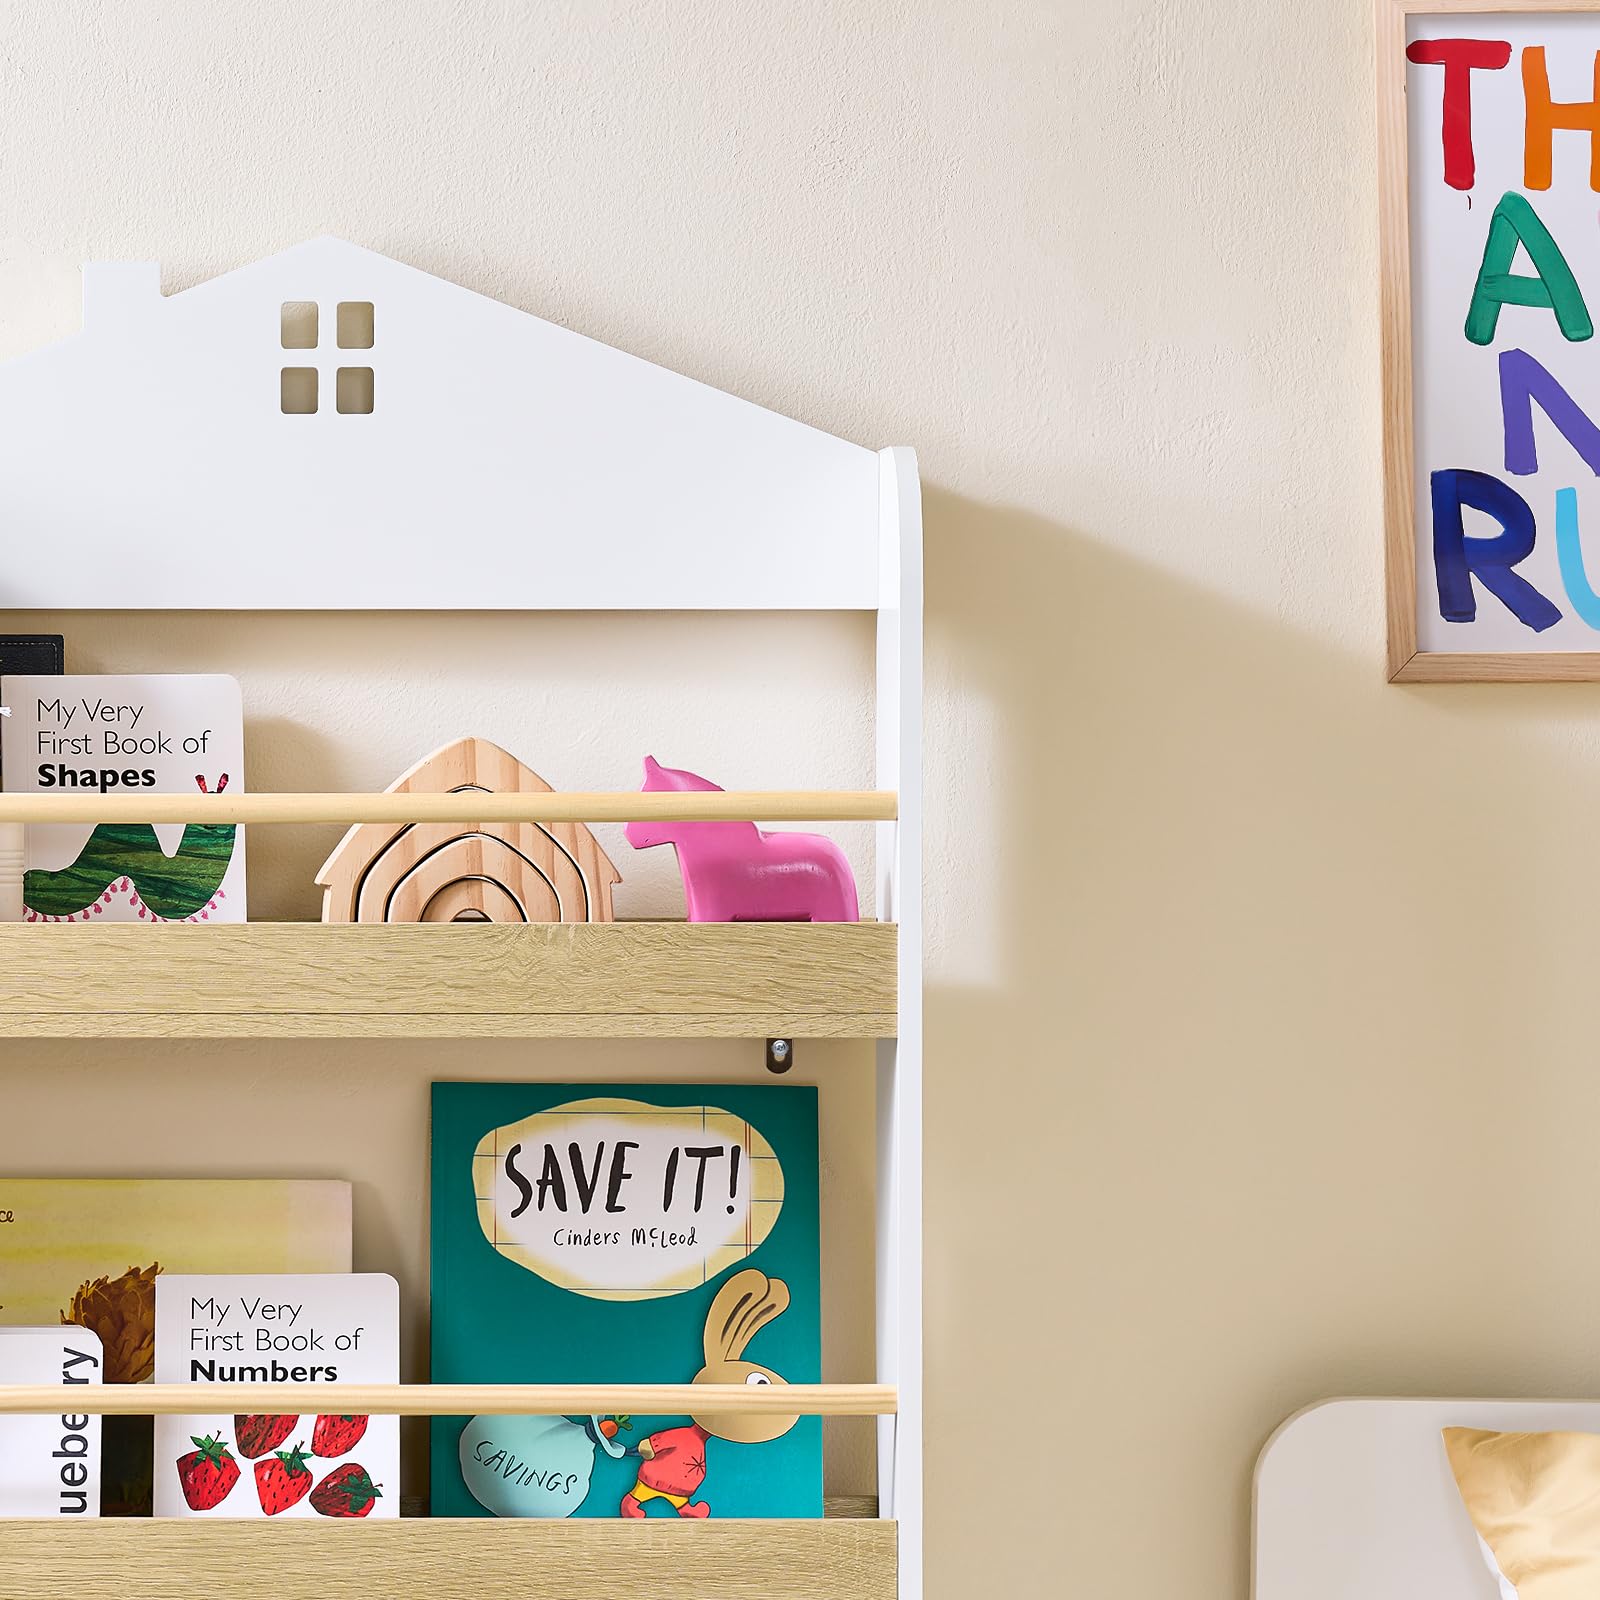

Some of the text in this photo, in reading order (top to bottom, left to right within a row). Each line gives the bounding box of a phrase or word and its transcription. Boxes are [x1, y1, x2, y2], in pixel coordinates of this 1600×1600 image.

[37, 698, 144, 730] My Very
[37, 729, 212, 755] First Book of
[37, 763, 156, 793] Shapes
[504, 1140, 742, 1219] SAVE IT!
[553, 1226, 698, 1249] Cinders McLeod
[190, 1297, 303, 1327] My Very
[190, 1327, 364, 1352] First Book of
[190, 1358, 338, 1383] Numbers
[473, 1440, 578, 1495] SAVINGS
